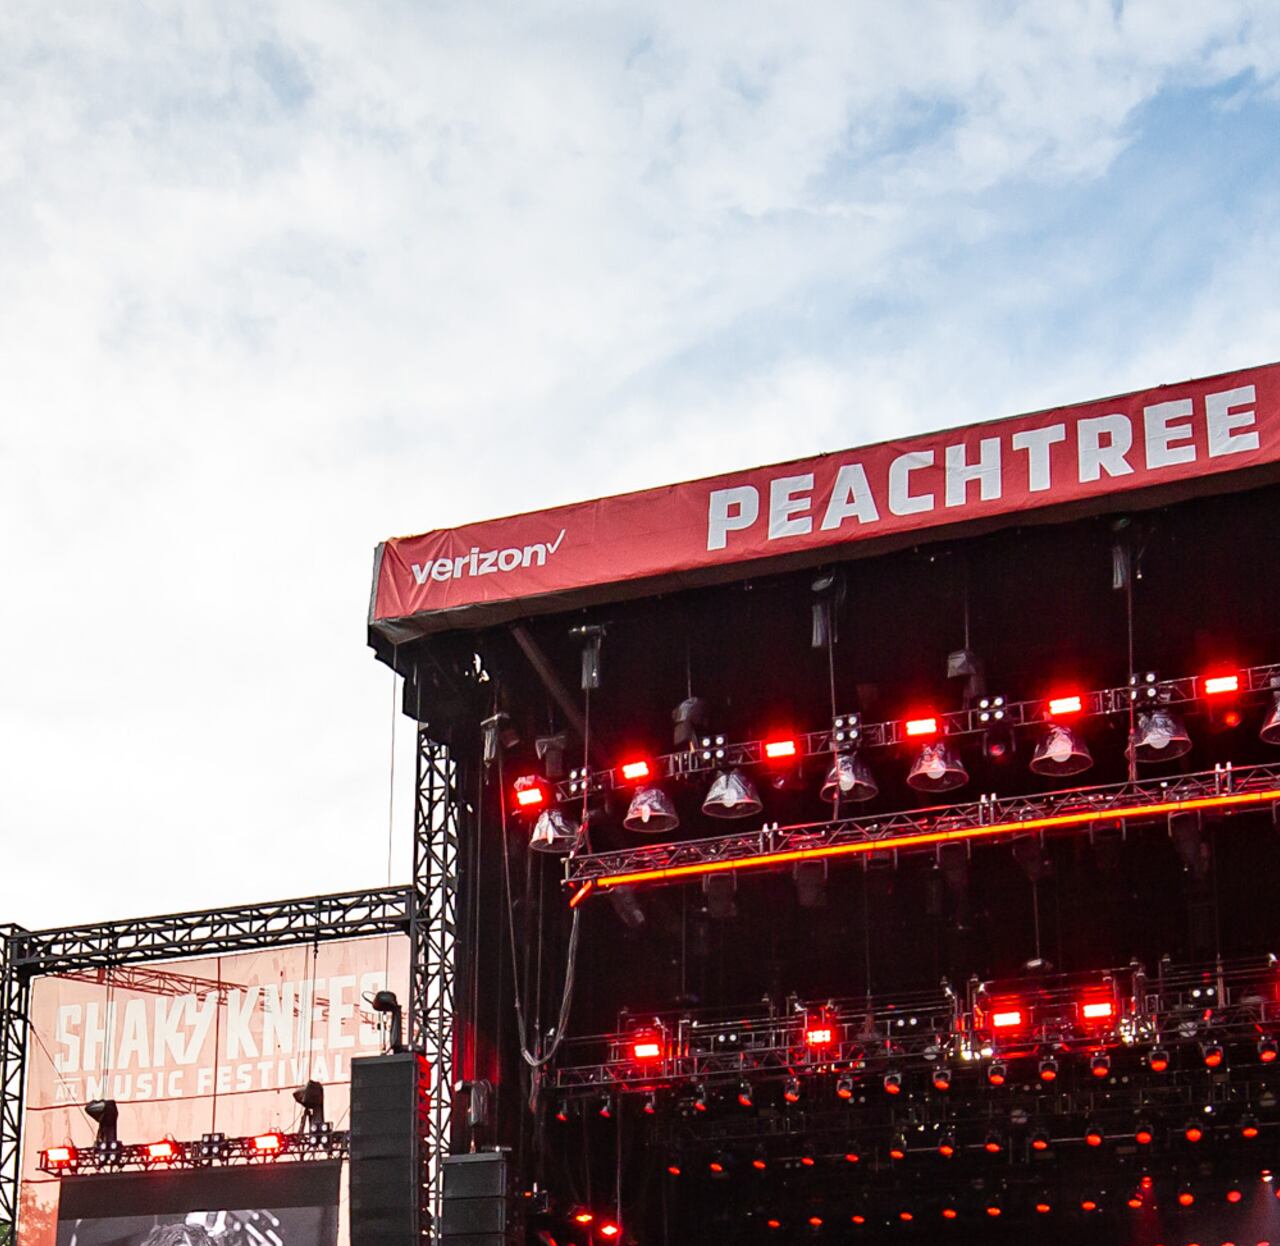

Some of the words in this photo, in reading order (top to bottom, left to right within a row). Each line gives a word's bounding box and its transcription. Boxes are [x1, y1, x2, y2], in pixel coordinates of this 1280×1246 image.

[706, 384, 1260, 552] PEACHTREE
[411, 542, 547, 585] verizon
[55, 993, 217, 1073] SHAKY
[226, 970, 387, 1061] KNEES
[86, 1069, 183, 1102] MUSIC
[197, 1054, 351, 1094] FESTIVAL
